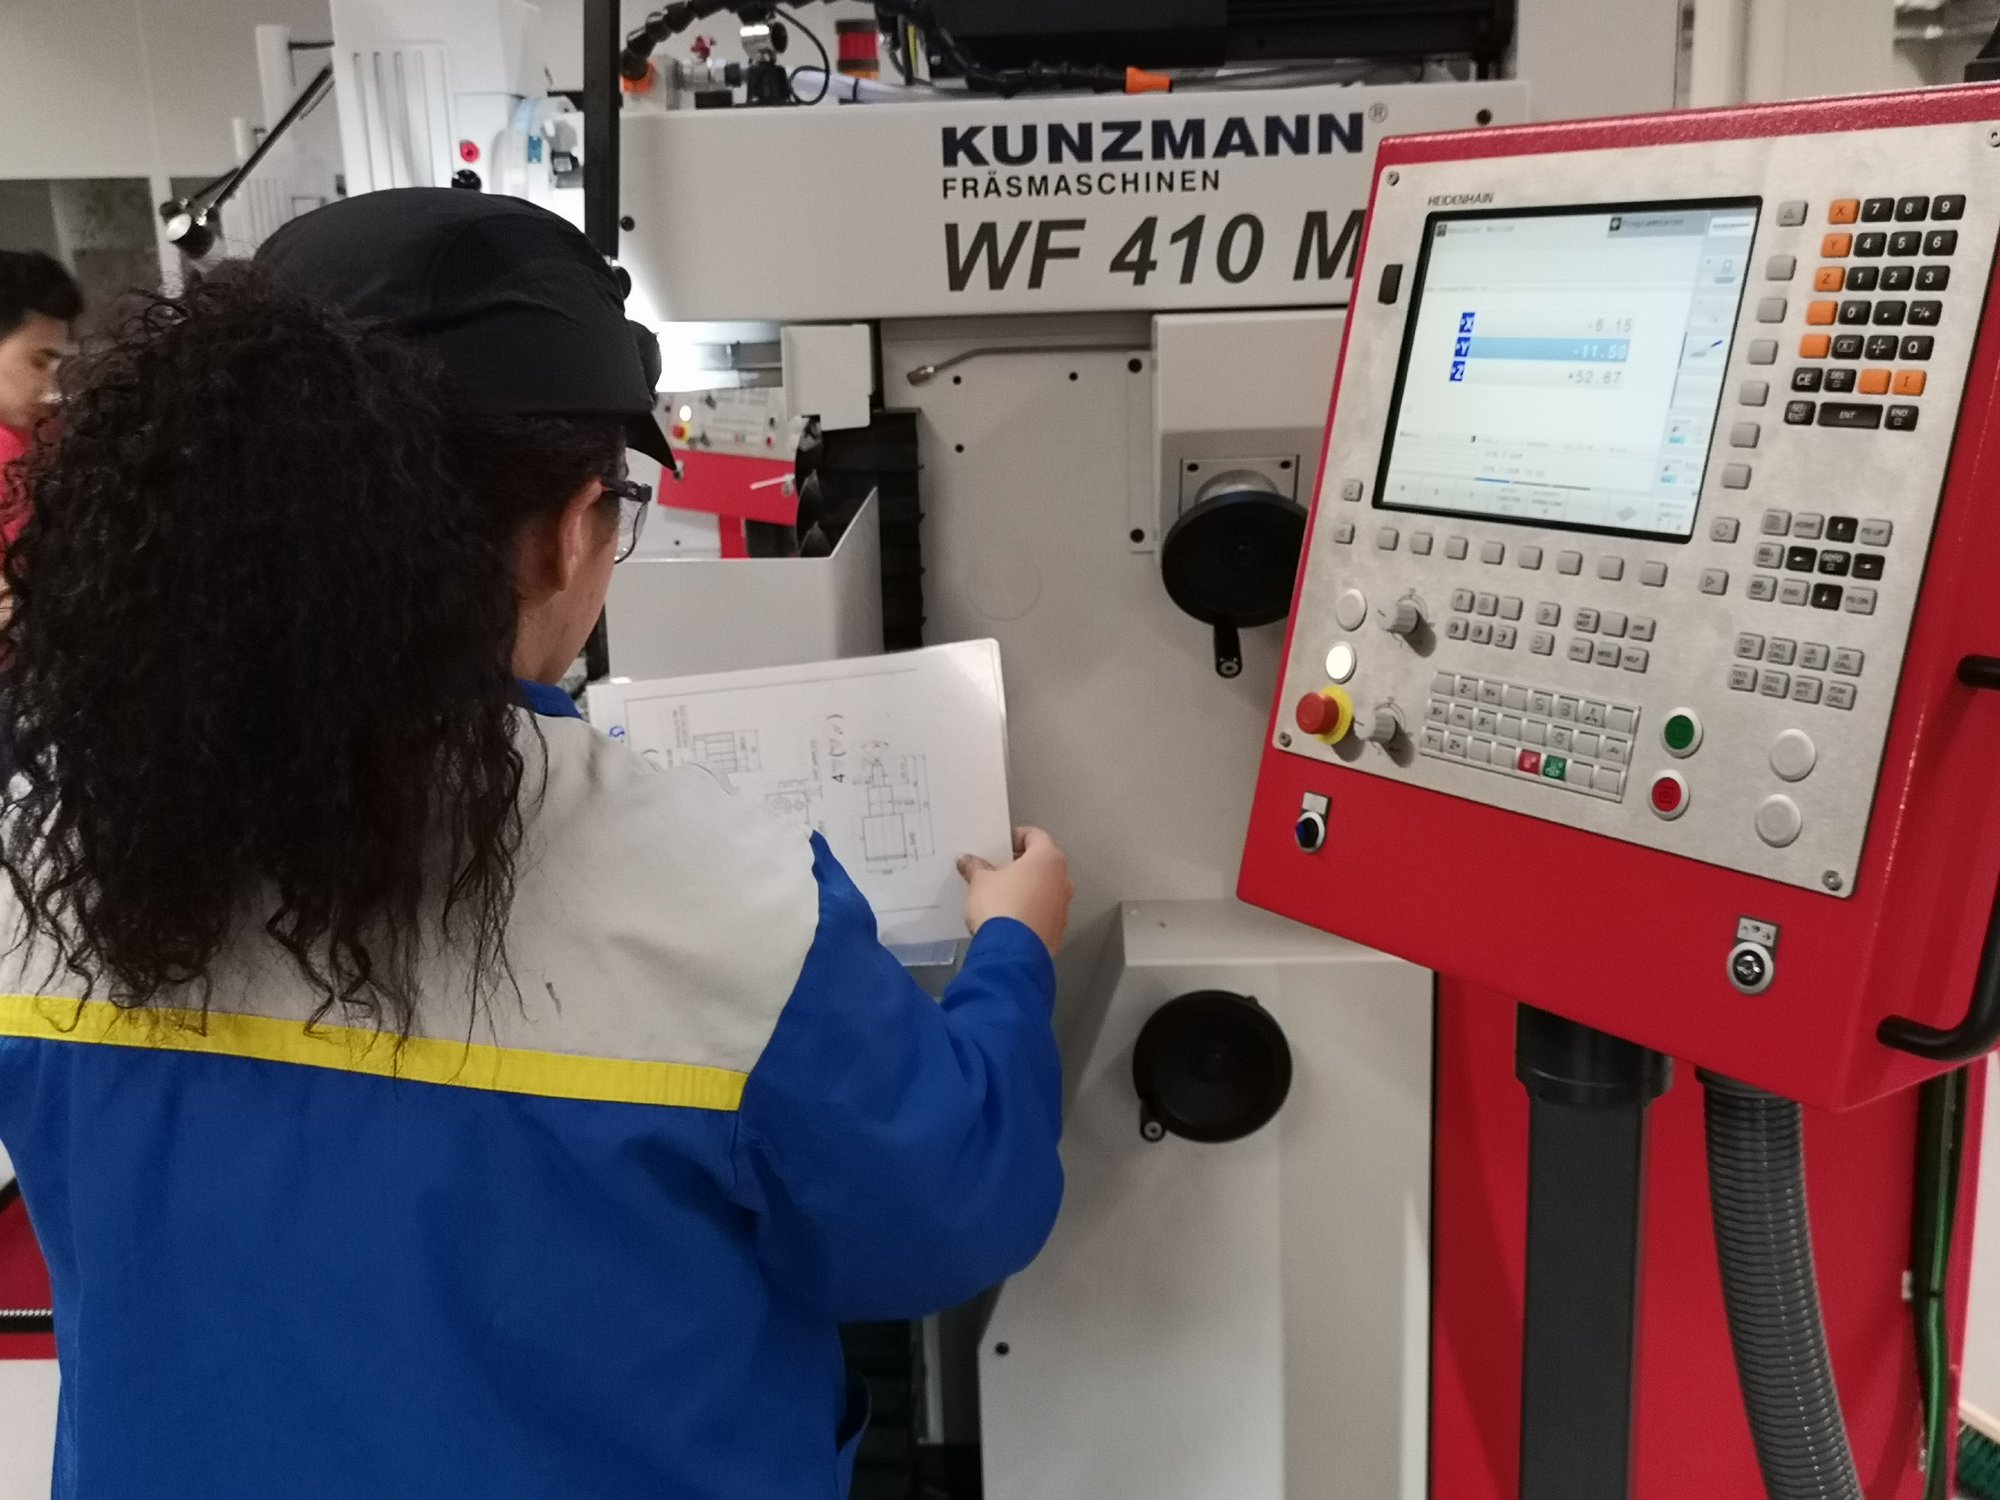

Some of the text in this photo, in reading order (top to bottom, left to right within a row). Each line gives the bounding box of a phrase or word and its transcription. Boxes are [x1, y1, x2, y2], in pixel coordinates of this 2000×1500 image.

[942, 113, 1364, 166] KUNZMANN
[942, 170, 1220, 198] FRÄSMASCHINEN
[1427, 193, 1494, 206] HEIDENHAIN
[1872, 203, 1880, 215] 7
[1905, 202, 1913, 214] 8
[1941, 201, 1950, 213] 9
[1863, 238, 1871, 249] 4
[1898, 237, 1906, 248] 5
[1933, 236, 1941, 248] 6
[944, 219, 1086, 291] WF
[1110, 213, 1265, 286] 410
[1857, 272, 1863, 283] 1
[1889, 272, 1897, 283] 2
[1925, 272, 1933, 283] 3
[1908, 341, 1918, 354] Q
